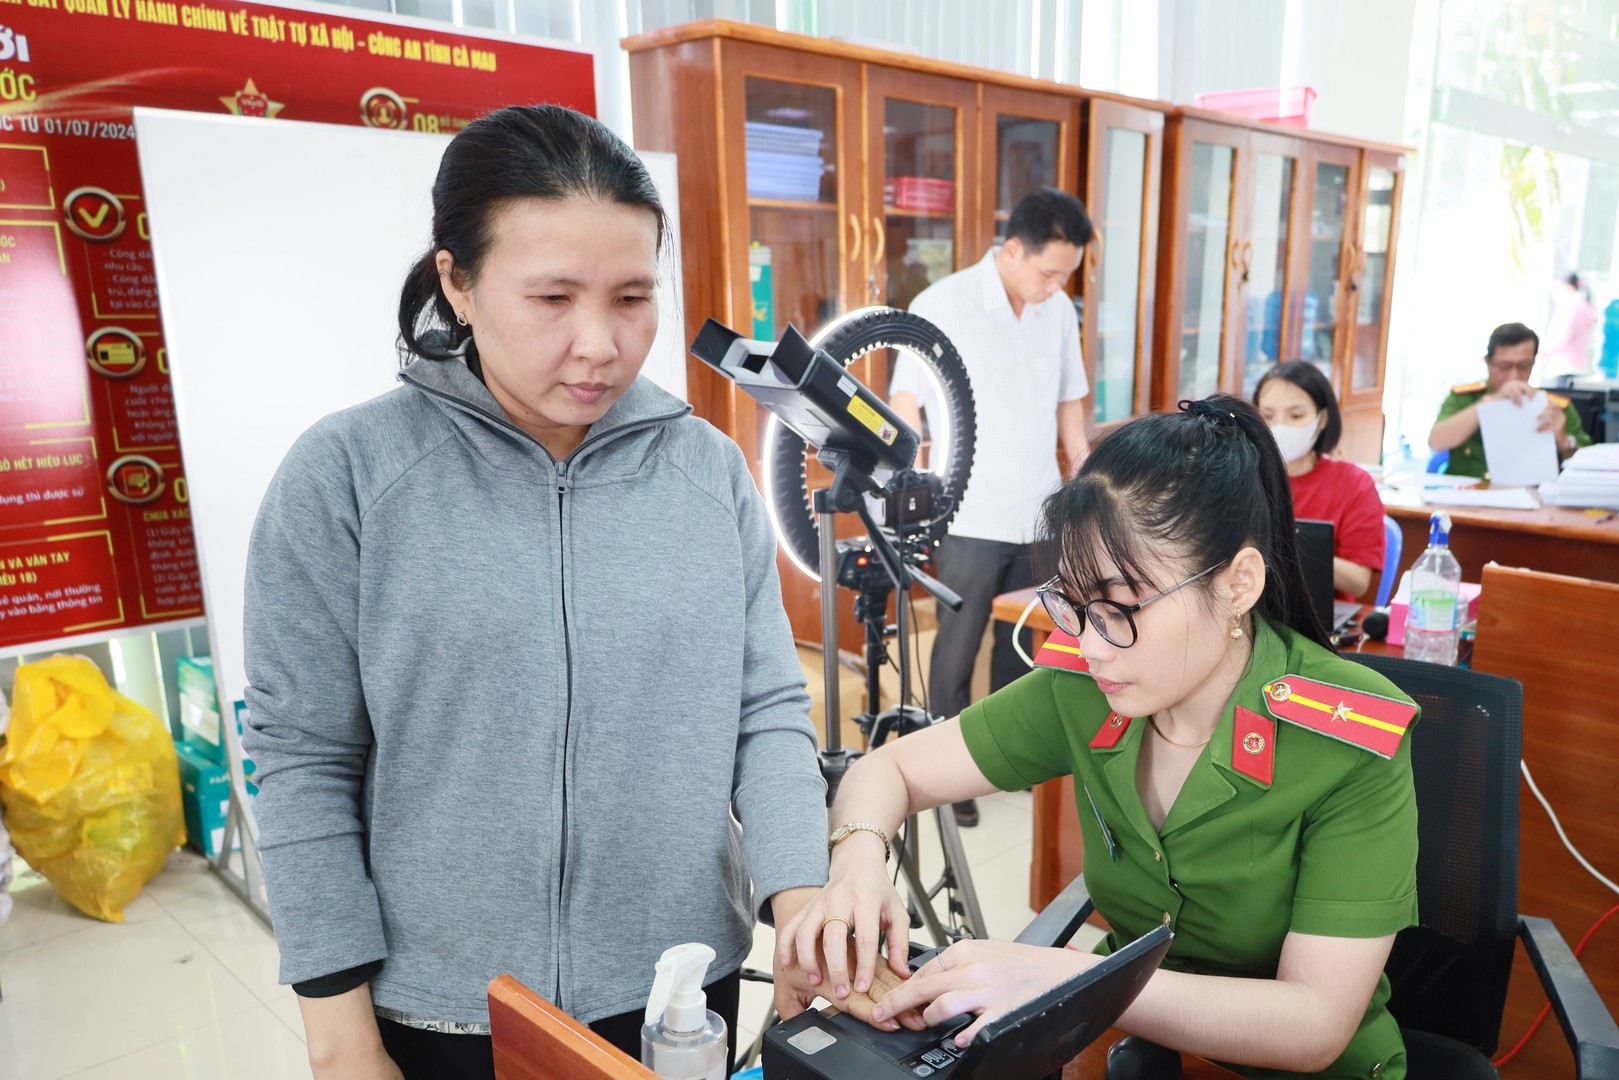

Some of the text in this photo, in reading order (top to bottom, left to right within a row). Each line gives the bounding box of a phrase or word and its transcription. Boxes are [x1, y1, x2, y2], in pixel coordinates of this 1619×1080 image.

[181, 3, 227, 32] CHÍNH
[229, 8, 249, 36] VỀ
[251, 14, 286, 43] TRẬT
[289, 20, 307, 48] TỰ
[310, 22, 330, 48] XÃ
[331, 25, 355, 53] HỘI
[368, 30, 402, 58] CÔNG
[404, 38, 421, 61] AN
[453, 43, 469, 68] CÀ
[471, 48, 496, 72] MAU
[19, 112, 39, 132] TỪ
[44, 116, 136, 139] 01/07/2024
[14, 456, 33, 470] HẾT
[36, 454, 60, 469] HIỆU
[63, 453, 84, 467] LỰC
[7, 556, 23, 569] VÀ
[25, 553, 48, 567] VÂN
[50, 551, 70, 564] TAY
[19, 570, 37, 584] 18)
[45, 588, 62, 599] nơi
[64, 583, 102, 597] thường
[57, 597, 88, 609] thông
[88, 594, 103, 605] tin
